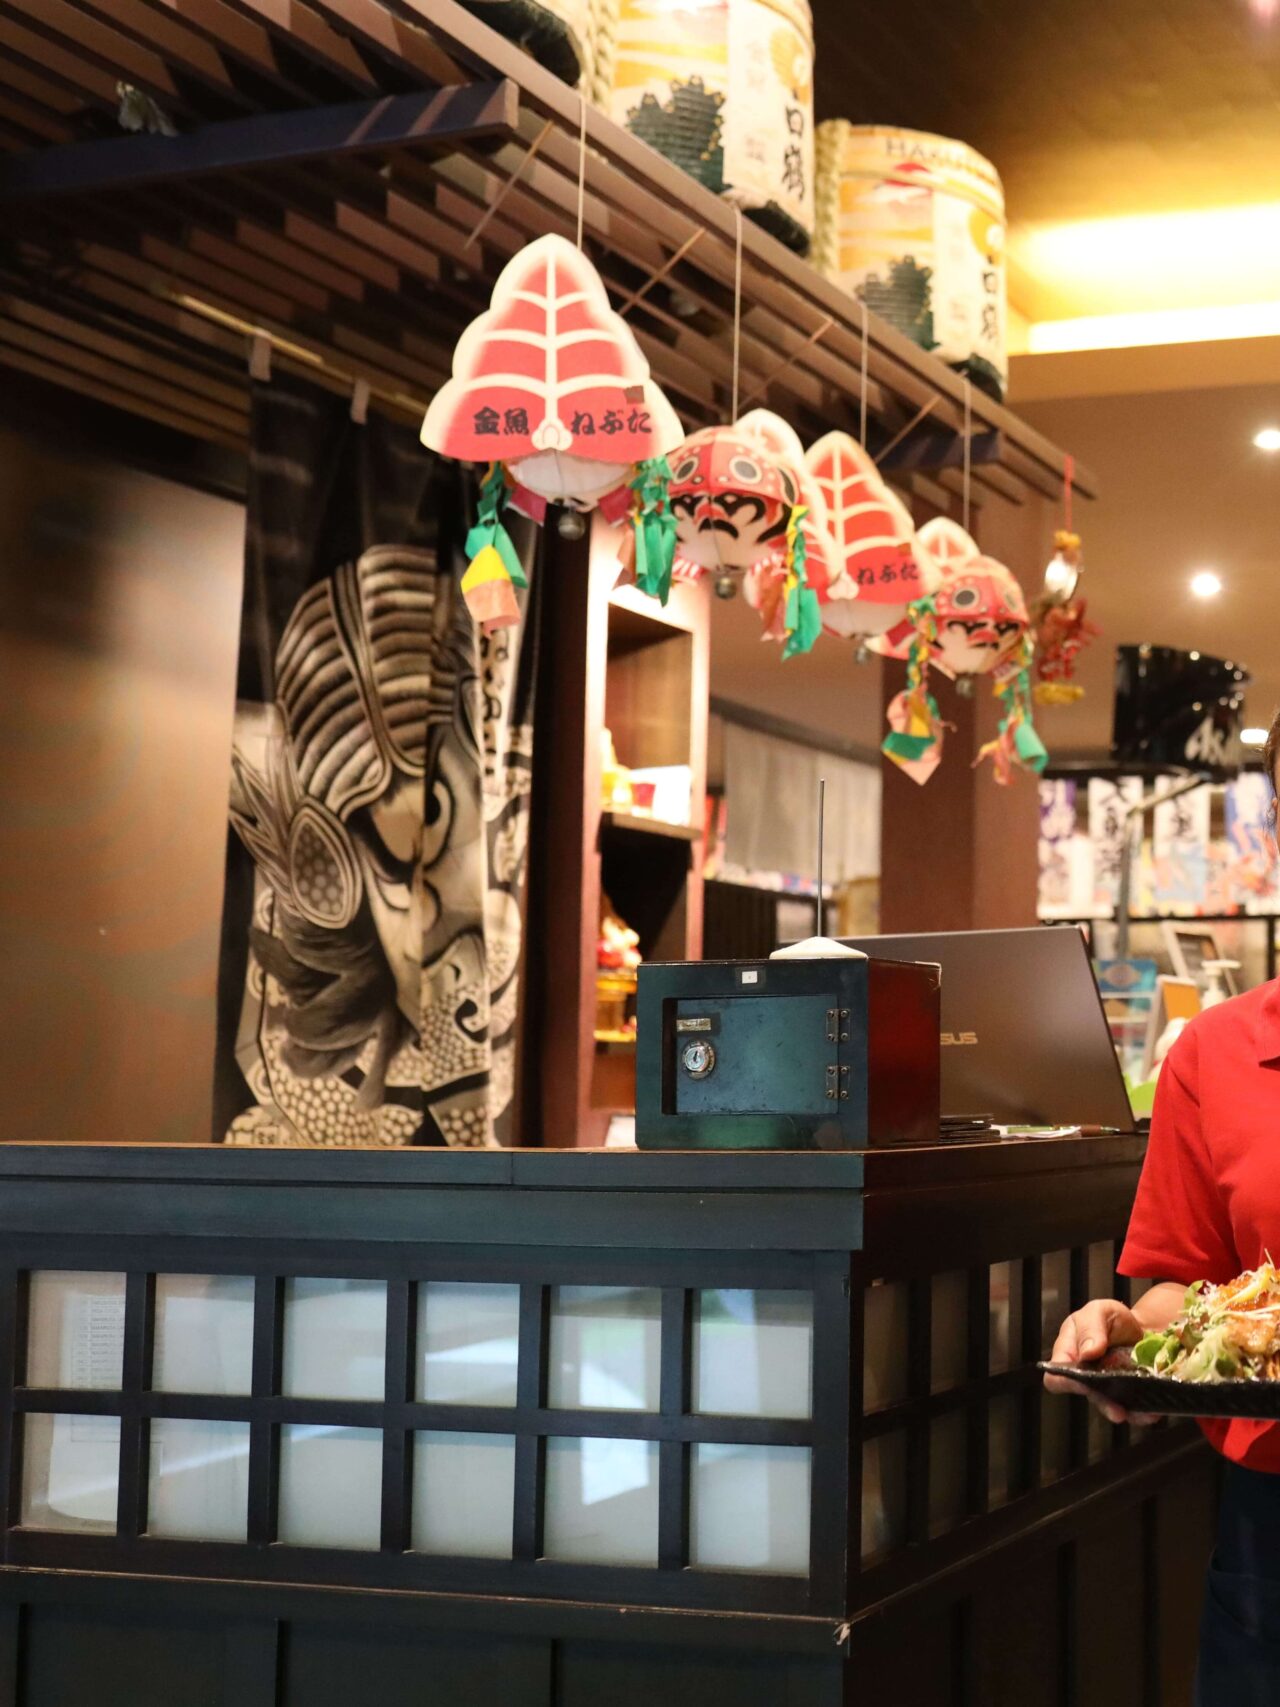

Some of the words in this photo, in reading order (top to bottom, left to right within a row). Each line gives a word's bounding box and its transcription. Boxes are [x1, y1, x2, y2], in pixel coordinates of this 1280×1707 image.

[473, 406, 530, 436] 金魚
[571, 408, 652, 436] ねぶた
[856, 560, 919, 586] ねぶた
[939, 1031, 979, 1046] SUS
